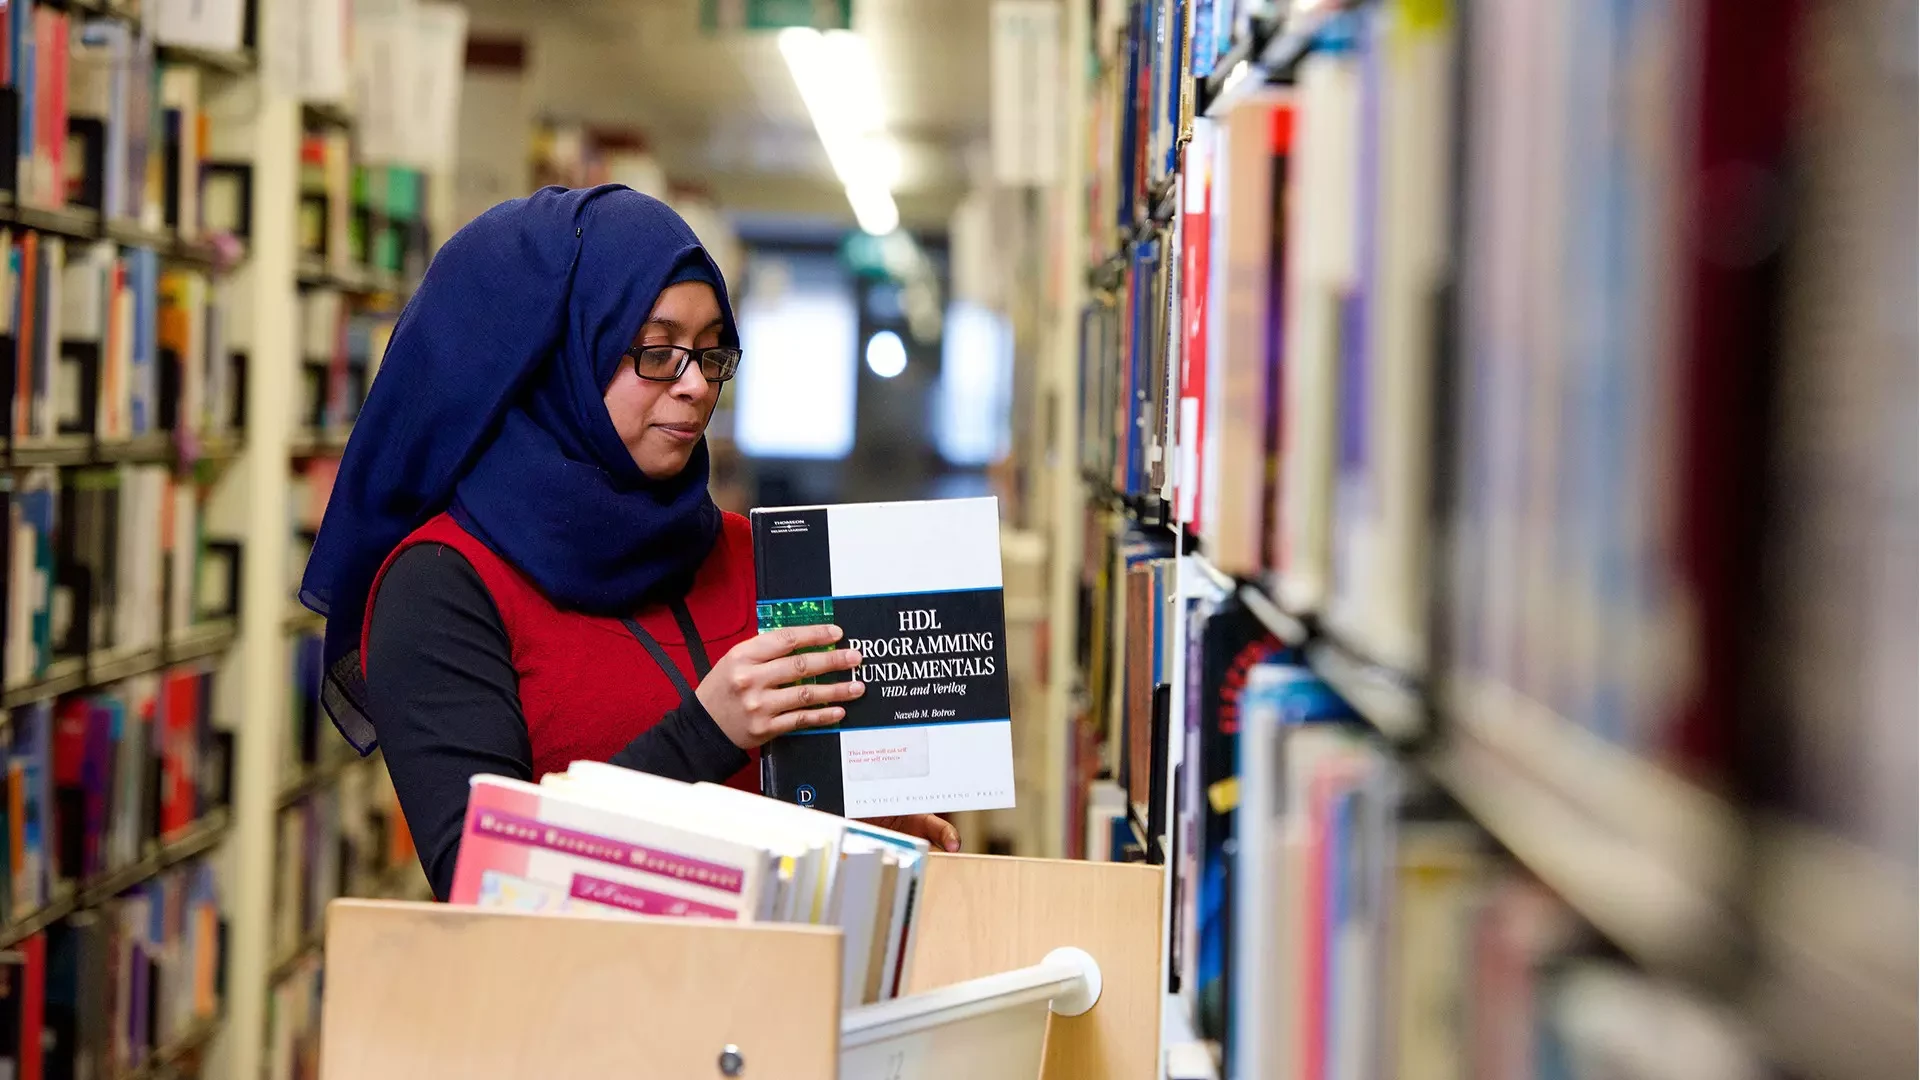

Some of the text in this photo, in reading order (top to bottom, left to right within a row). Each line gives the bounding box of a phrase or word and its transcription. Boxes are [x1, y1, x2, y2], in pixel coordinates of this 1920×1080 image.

[898, 609, 942, 631] HDL
[848, 632, 994, 658] PROGRAMMING
[851, 656, 996, 682] FUNDAMENTALS
[881, 681, 967, 698] VHDL and Verilog
[894, 708, 956, 720] Nazeib M. Botros
[800, 790, 812, 802] D
